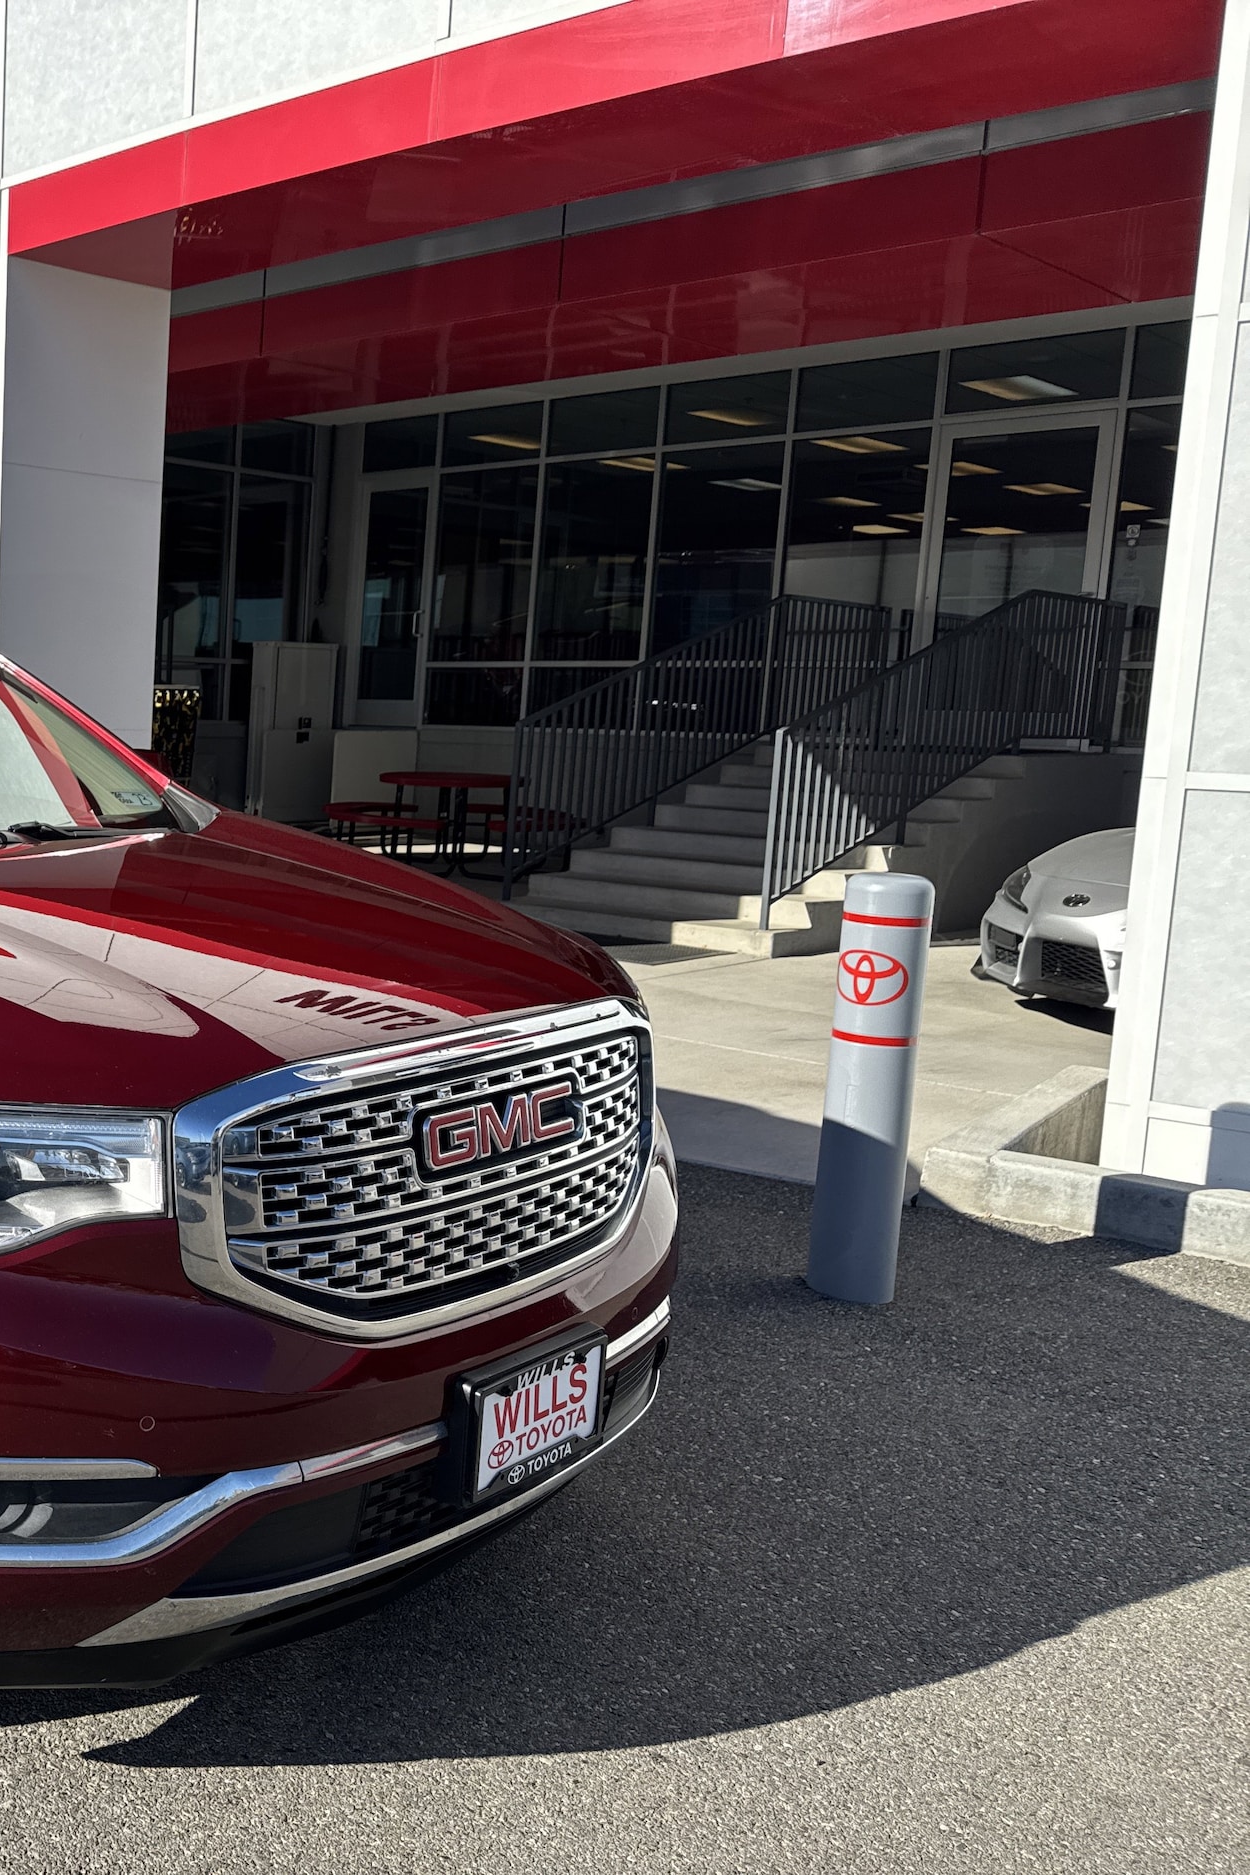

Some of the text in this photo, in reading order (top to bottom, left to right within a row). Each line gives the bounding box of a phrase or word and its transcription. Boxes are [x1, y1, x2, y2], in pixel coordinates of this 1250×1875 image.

[423, 1081, 575, 1171] GMC
[516, 1351, 576, 1390] WILLS
[493, 1362, 588, 1440] WILLS
[515, 1404, 588, 1456] TOYOTA
[527, 1441, 573, 1476] TOYOTA
